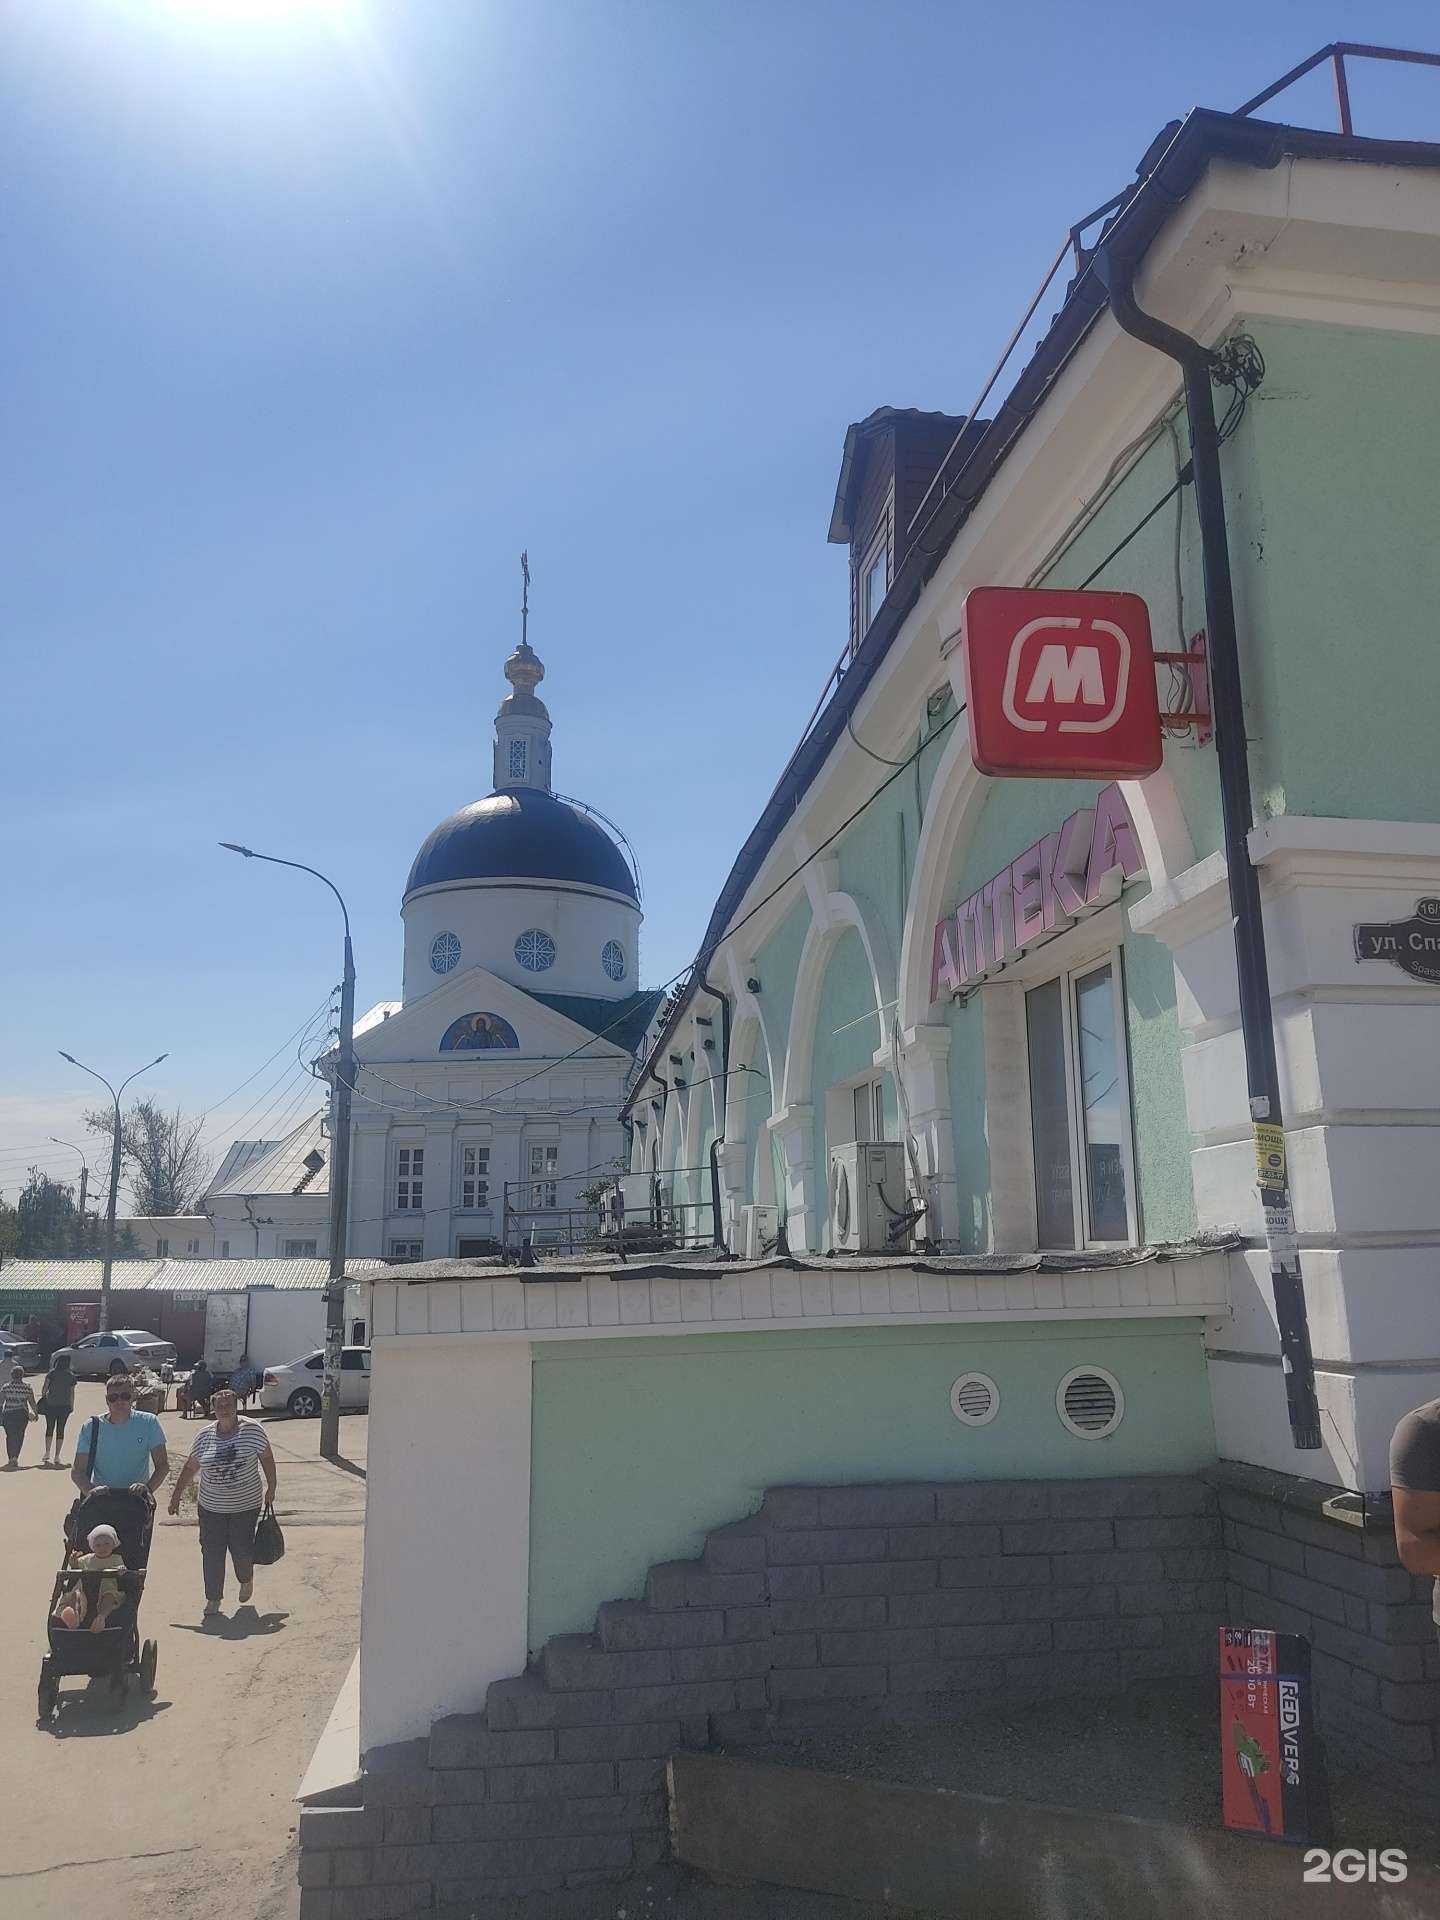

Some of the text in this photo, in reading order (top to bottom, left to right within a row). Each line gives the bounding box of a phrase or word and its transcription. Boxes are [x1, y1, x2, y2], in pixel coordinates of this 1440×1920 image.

[1025, 644, 1105, 706] М
[930, 781, 1146, 1004] АПТЕКА
[1371, 936, 1402, 954] ул.
